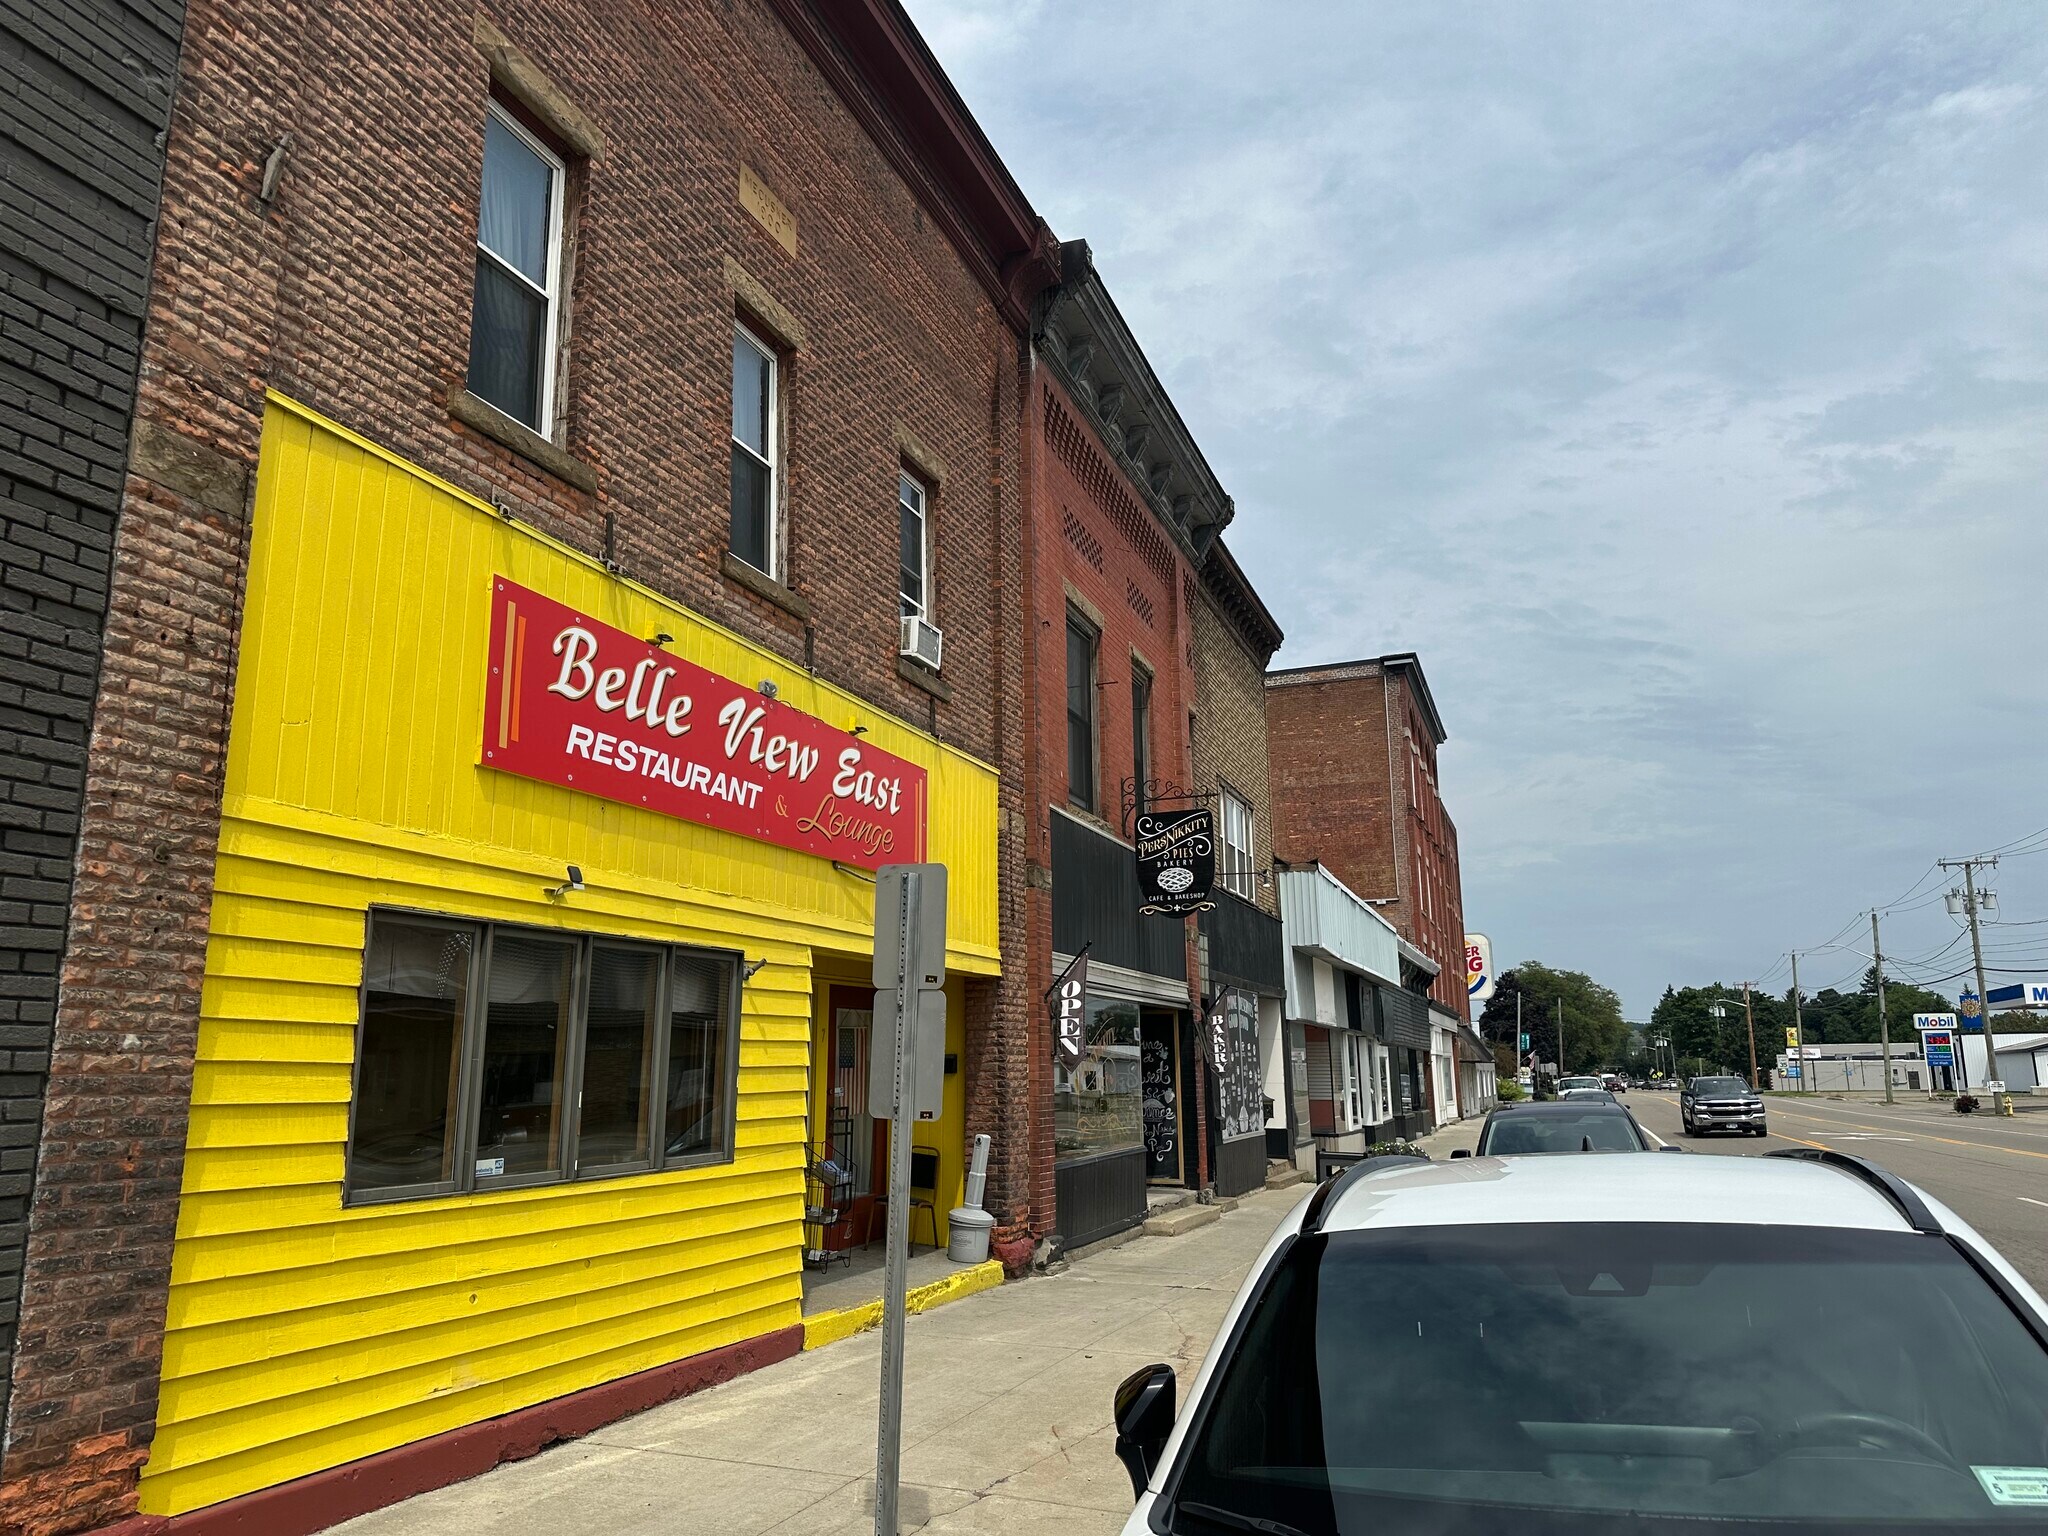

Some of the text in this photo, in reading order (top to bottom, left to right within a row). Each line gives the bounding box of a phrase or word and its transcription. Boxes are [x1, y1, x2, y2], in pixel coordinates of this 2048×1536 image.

[547, 626, 902, 815] Belle View East
[565, 724, 763, 809] RESTAURANT
[775, 793, 895, 856] & Lounge
[1157, 859, 1194, 868] BAKERY
[1173, 847, 1194, 859] PIES
[1148, 894, 1164, 902] CAFE
[1174, 892, 1205, 901] BAKESHOP
[1059, 980, 1082, 1058] OPEN
[1917, 1016, 1954, 1027] Mobil
[1211, 1014, 1228, 1073] BAKERY
[1992, 1482, 2003, 1494] 5
